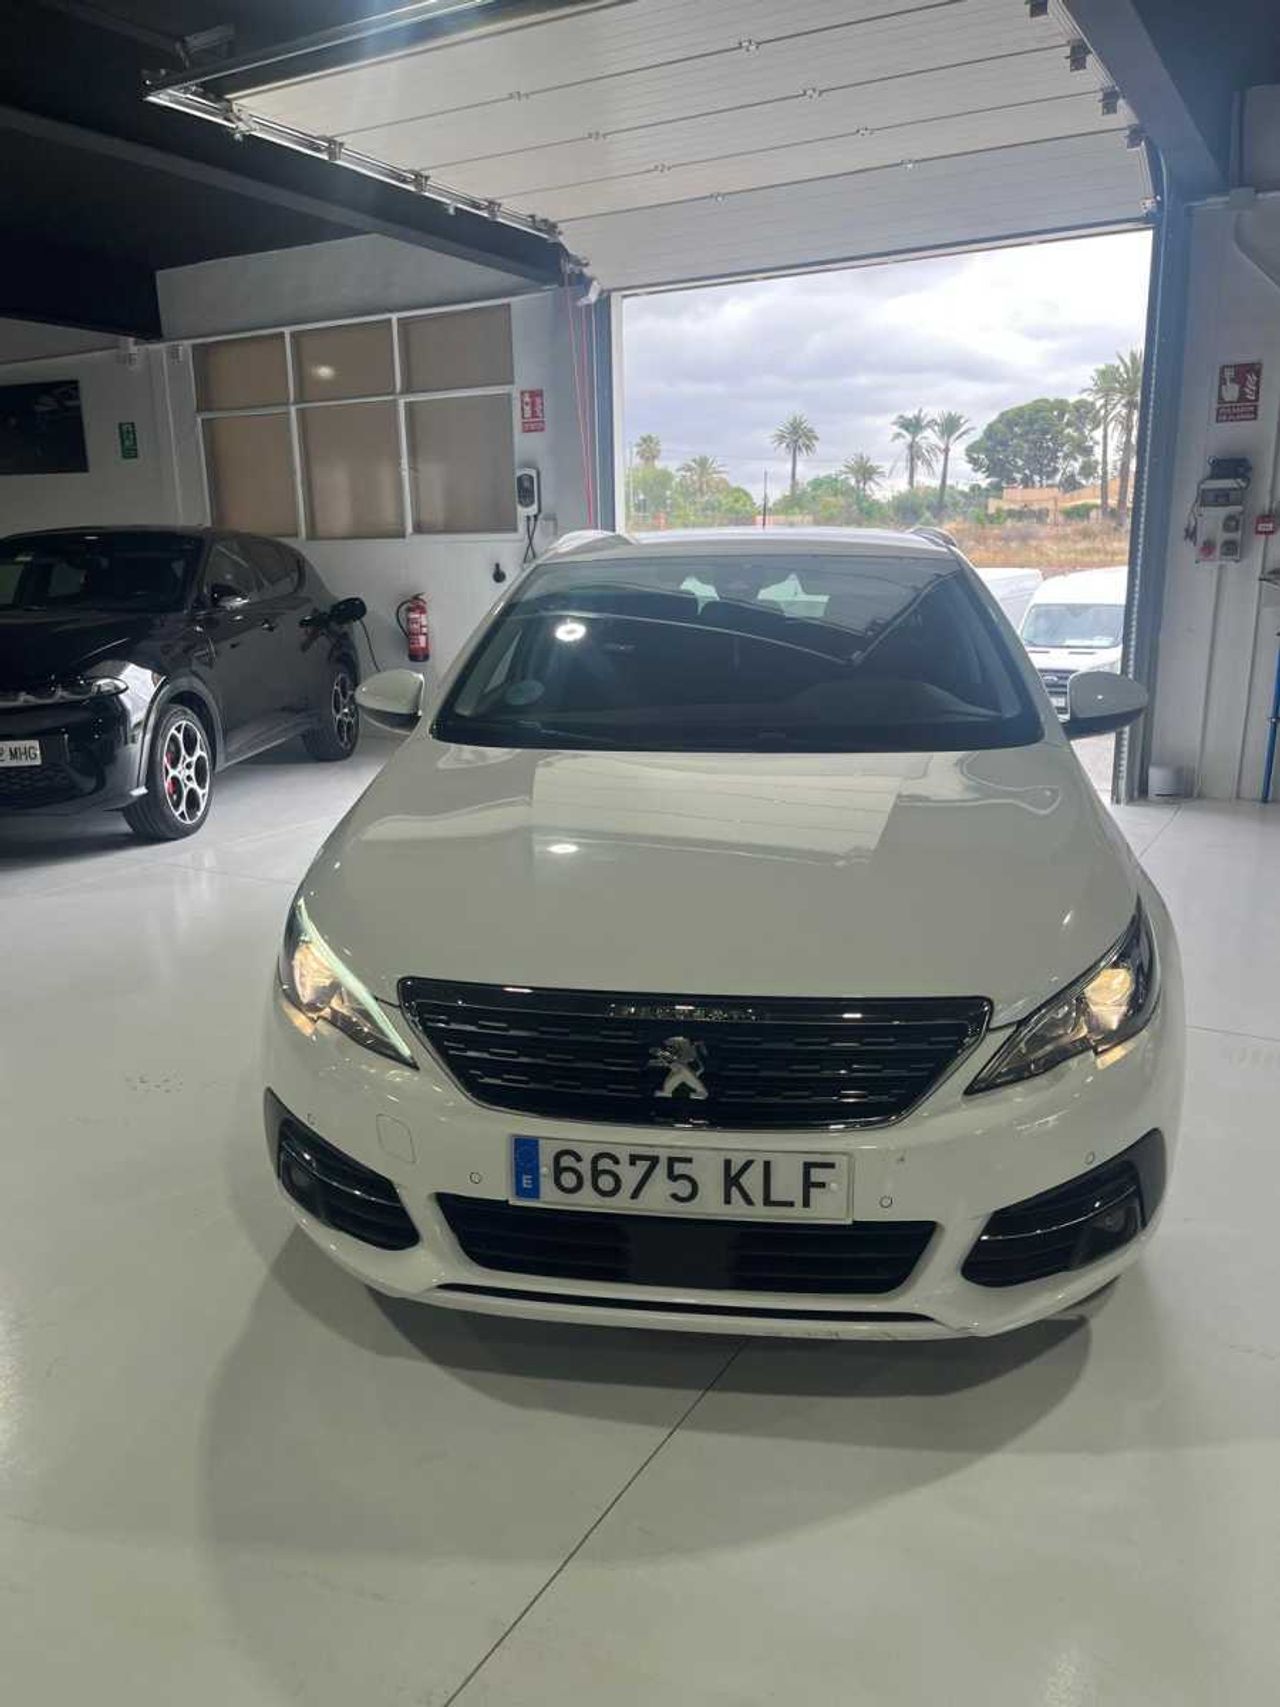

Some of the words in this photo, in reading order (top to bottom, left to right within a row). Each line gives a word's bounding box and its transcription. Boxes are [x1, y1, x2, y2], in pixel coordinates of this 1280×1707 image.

[9, 746, 37, 760] MHG
[521, 1173, 532, 1189] E
[553, 1149, 699, 1203] 6675
[723, 1158, 836, 1209] KLF
